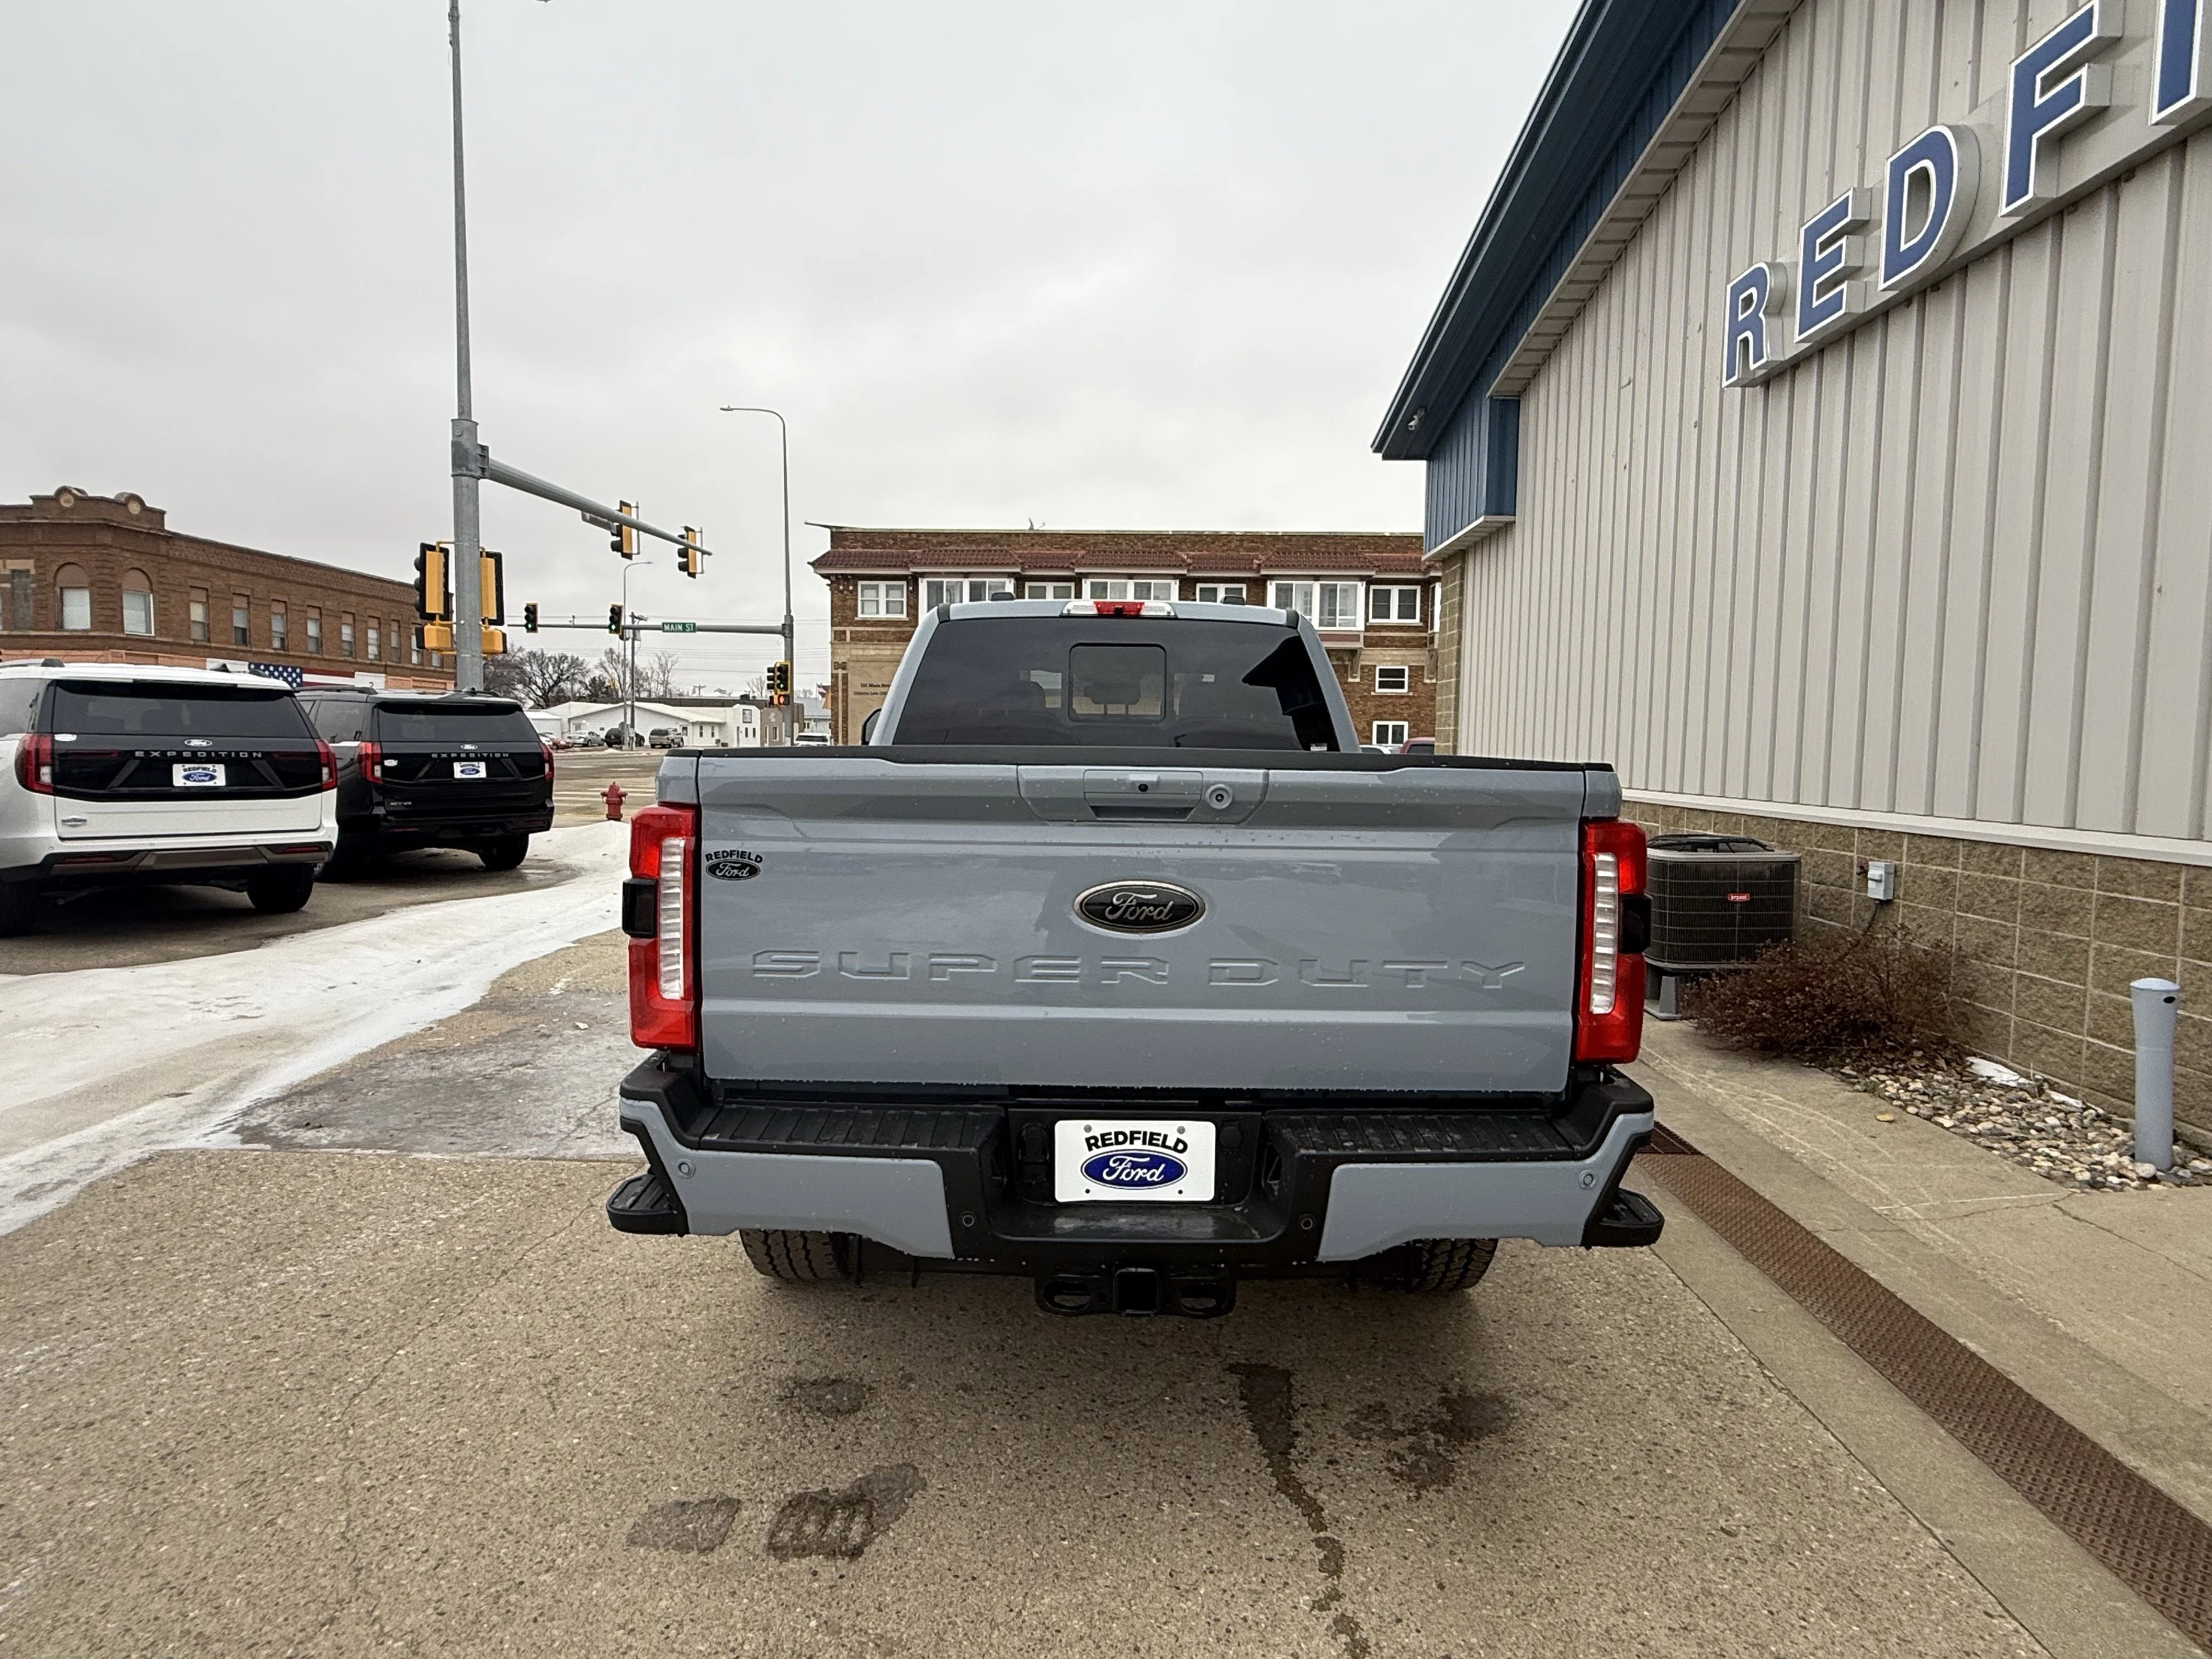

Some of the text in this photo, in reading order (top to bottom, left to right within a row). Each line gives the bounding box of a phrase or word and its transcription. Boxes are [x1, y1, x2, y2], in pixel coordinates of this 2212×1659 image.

[664, 623, 693, 631] MAIN ST
[705, 850, 763, 863] REDFIELD
[716, 863, 750, 876] Ford
[1105, 892, 1173, 920] Ford
[752, 950, 1525, 989] SUPER DUTY
[1085, 1130, 1188, 1154] REDFIELD
[1103, 1155, 1165, 1182] Ford
